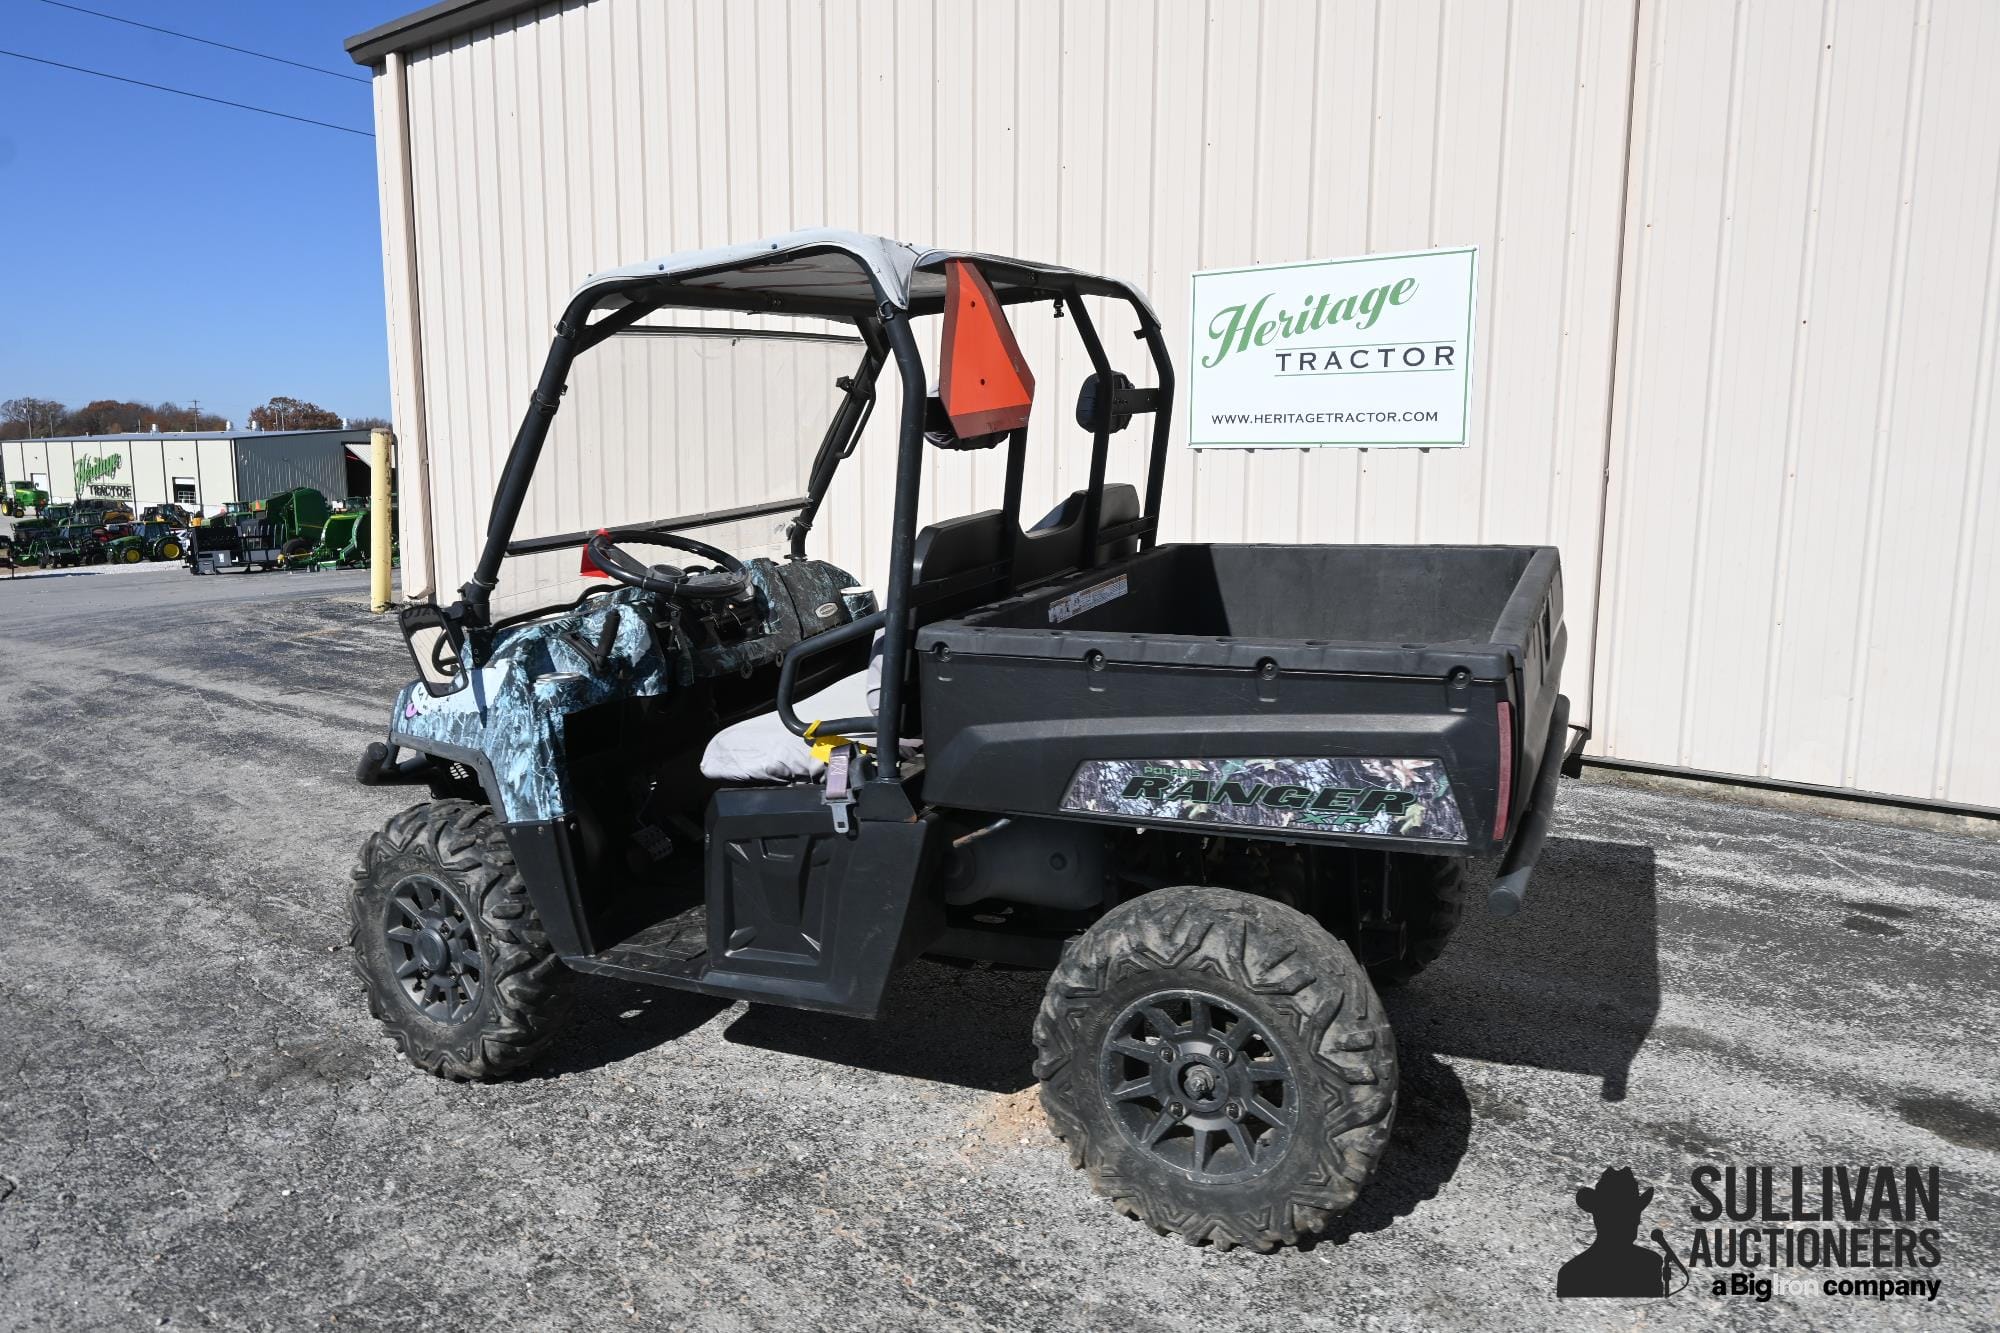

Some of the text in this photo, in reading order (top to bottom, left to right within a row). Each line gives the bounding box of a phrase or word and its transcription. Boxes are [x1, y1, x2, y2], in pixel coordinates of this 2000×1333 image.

[1202, 277, 1420, 369] Heritage
[1276, 346, 1455, 371] TRACTOR
[1212, 412, 1438, 424] WWW.HERITAGETRACTOR.COM
[1143, 766, 1202, 778] POLARIS
[1122, 776, 1417, 816] RANGER
[1295, 812, 1371, 826] XP
